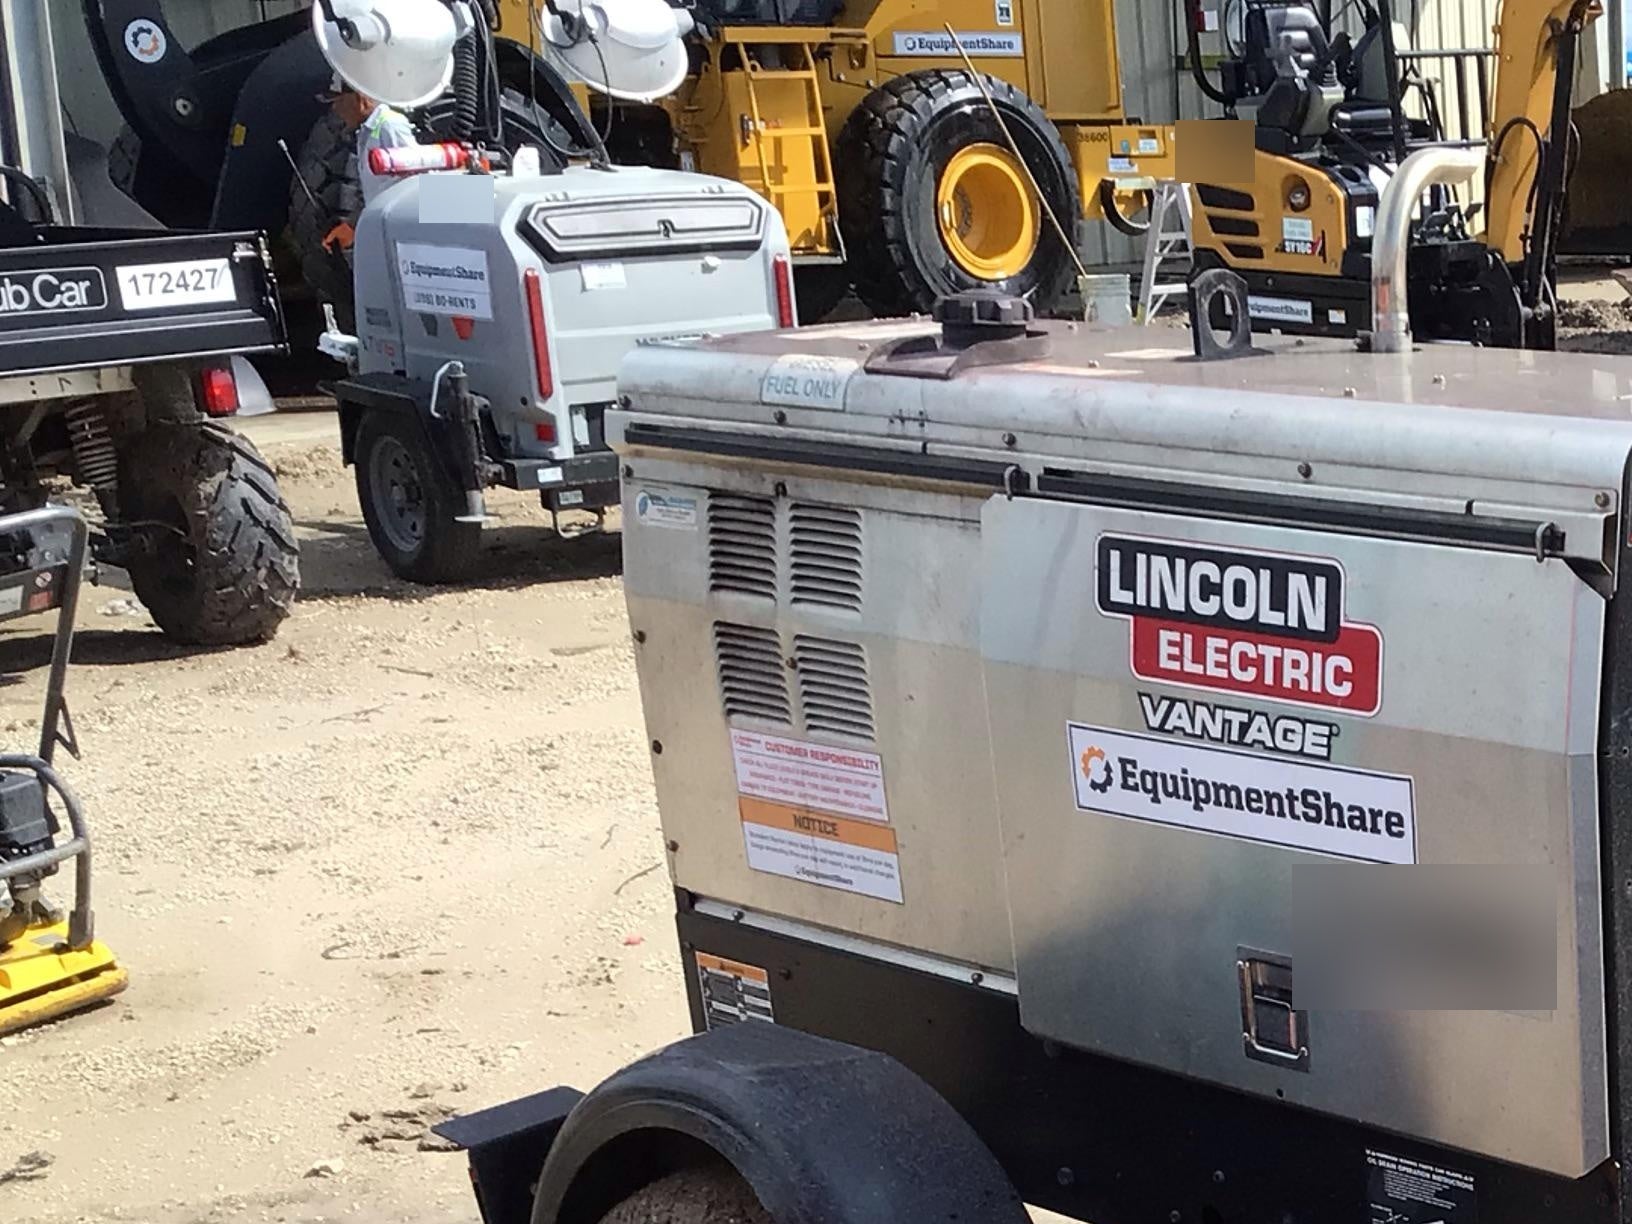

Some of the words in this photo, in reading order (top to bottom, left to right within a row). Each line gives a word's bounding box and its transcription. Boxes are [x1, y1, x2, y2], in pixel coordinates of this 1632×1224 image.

[32, 274, 90, 308] Car
[129, 268, 218, 297] 172427
[766, 375, 798, 396] FUEL
[803, 379, 841, 400] ONLY
[1109, 549, 1327, 632] LINCOLN
[1158, 629, 1354, 698] ELECTRIC
[1139, 693, 1331, 758] VANTAGE
[765, 741, 809, 758] CUSTOMER
[1118, 757, 1406, 839] EquipmentShare
[793, 814, 839, 836] NOTICE
